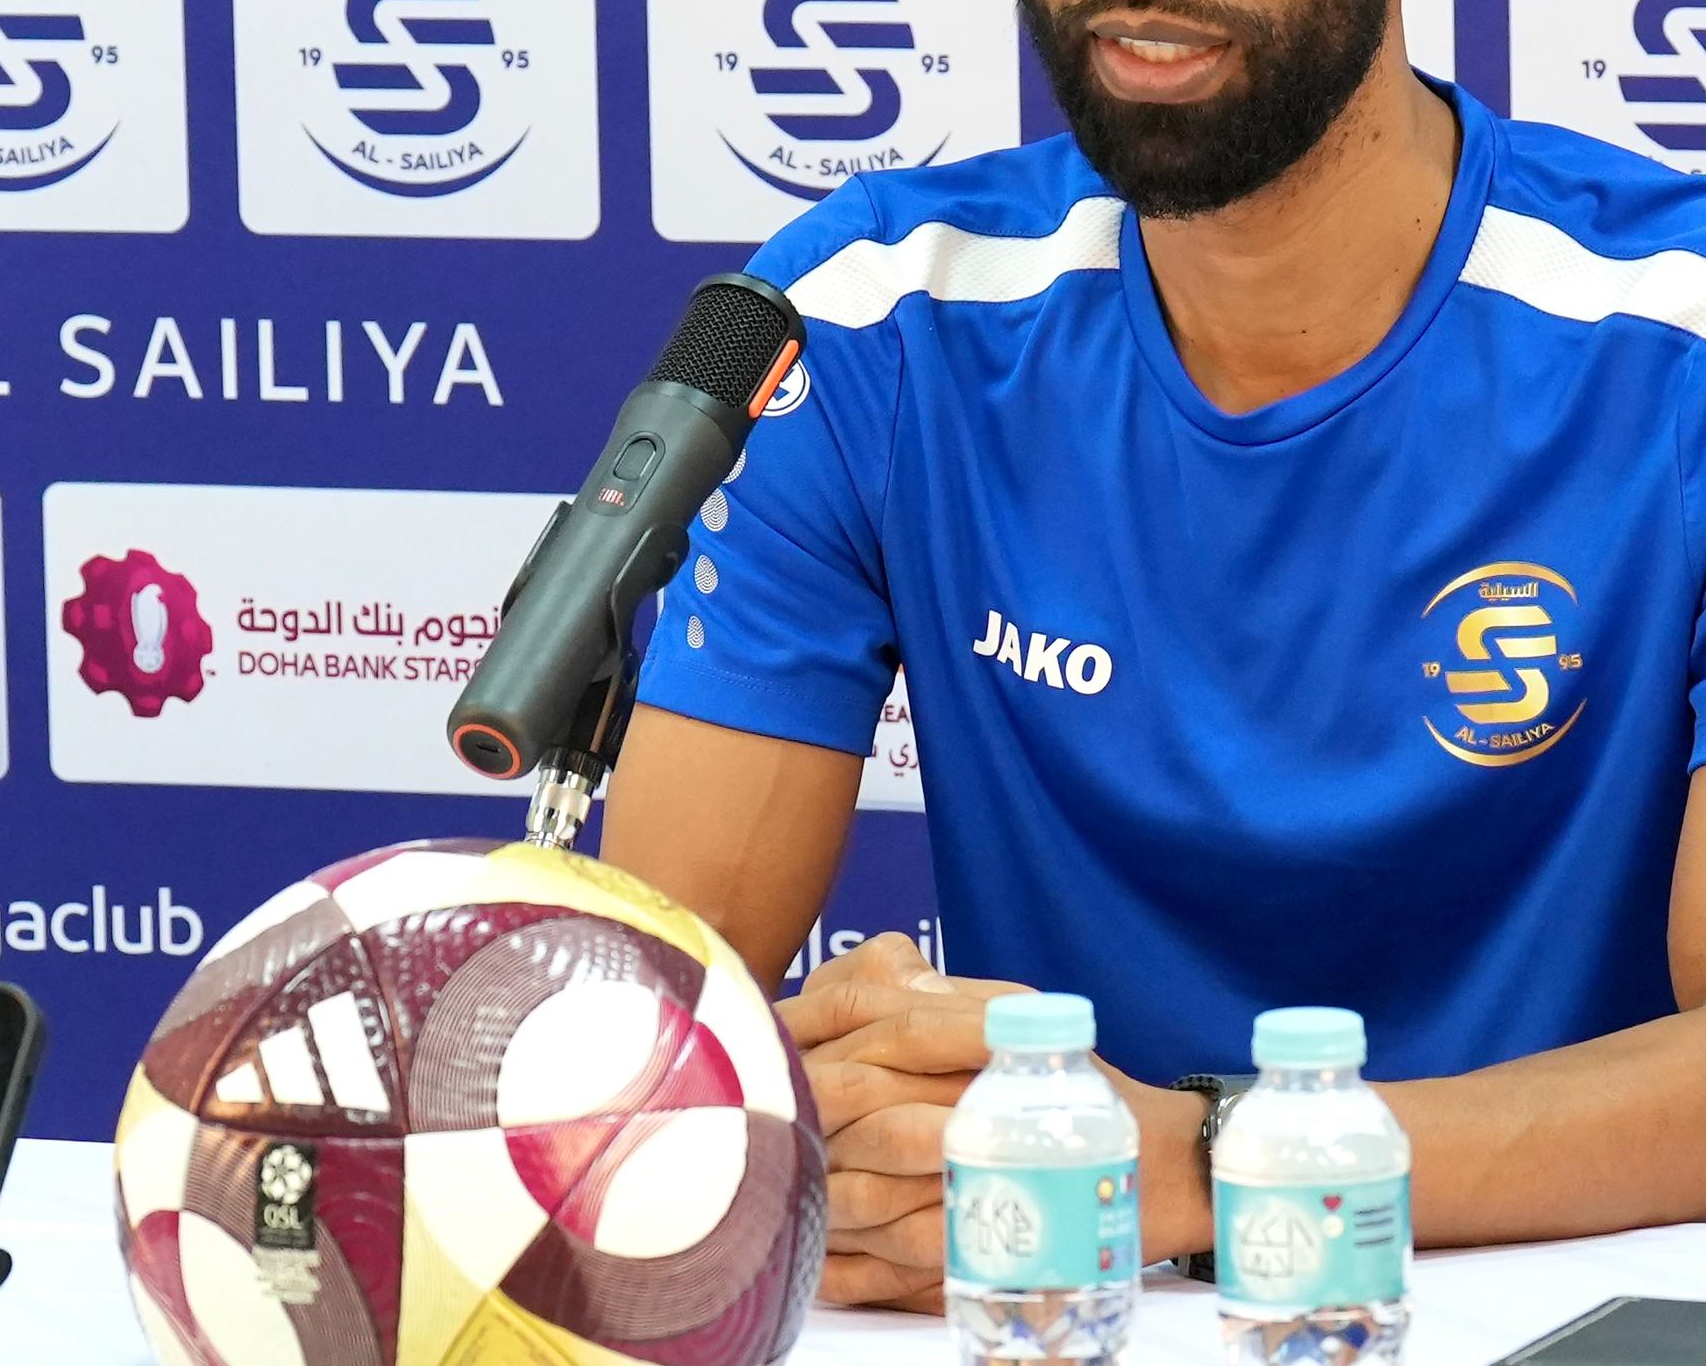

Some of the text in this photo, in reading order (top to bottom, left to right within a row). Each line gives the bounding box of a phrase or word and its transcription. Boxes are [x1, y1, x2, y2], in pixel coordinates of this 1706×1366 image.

[89, 44, 120, 66] 95
[60, 315, 503, 405] SAILIYA
[236, 598, 344, 644] الدوحة
[351, 602, 405, 648] بنك
[237, 650, 486, 683] DOHA BANK STAR
[973, 610, 1113, 695] JAKO
[1558, 653, 1583, 670] 95
[1422, 661, 1441, 678] 19
[1490, 723, 1555, 748] SAILIYA
